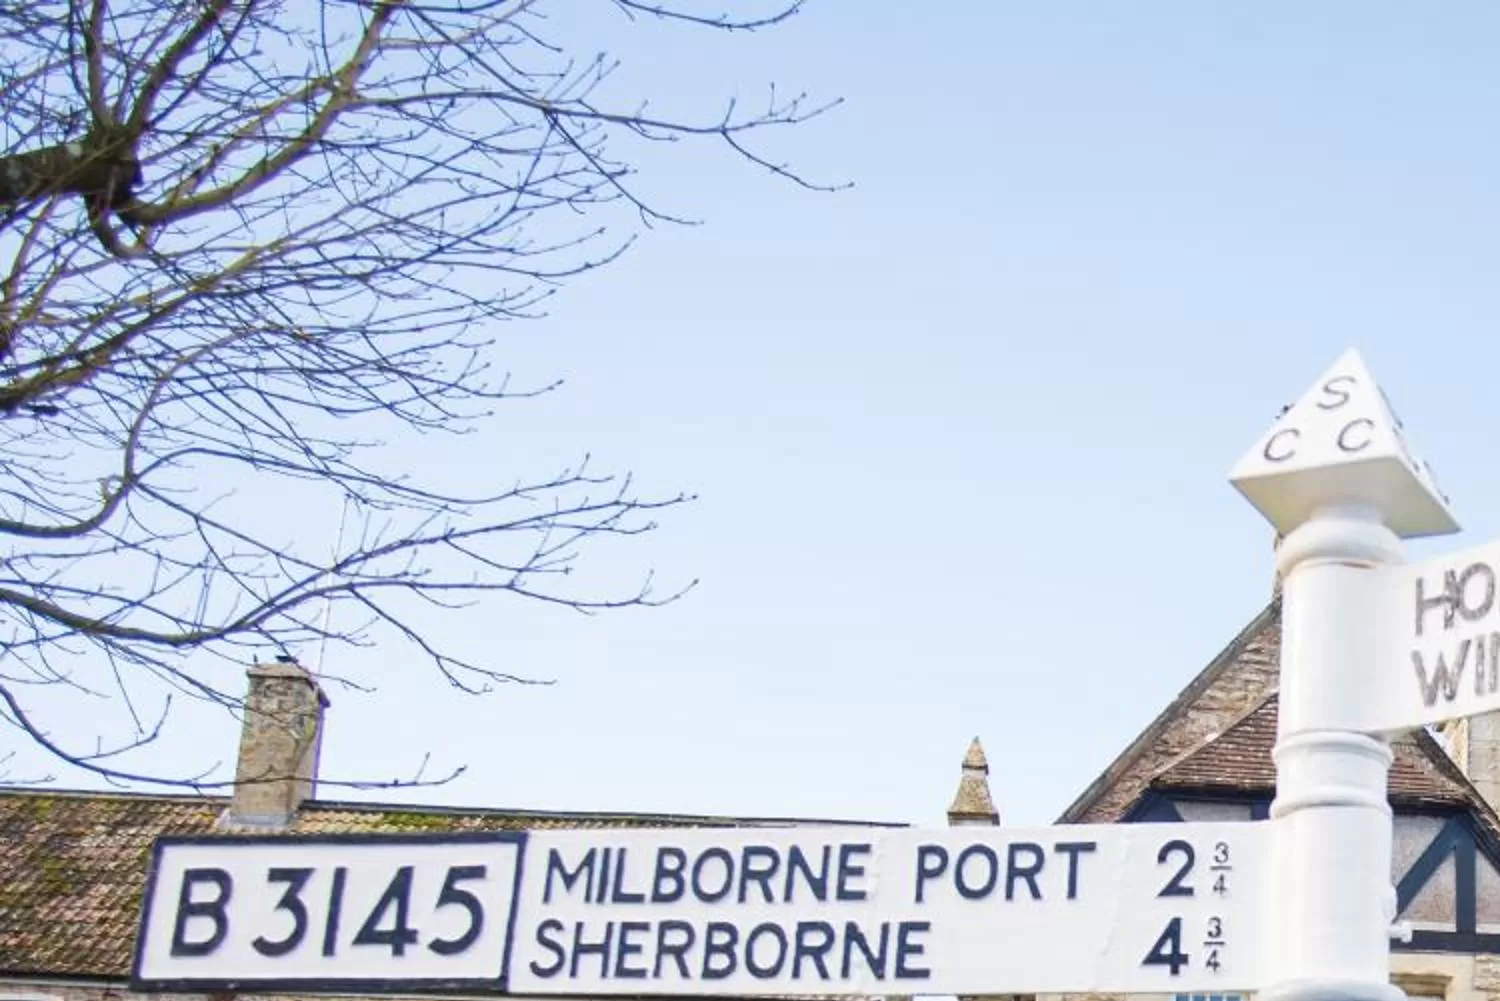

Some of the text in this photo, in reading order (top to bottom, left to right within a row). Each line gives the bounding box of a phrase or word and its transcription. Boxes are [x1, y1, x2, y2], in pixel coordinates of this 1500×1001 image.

[541, 842, 873, 905] MILBORNE
[913, 841, 1097, 902] PORT
[169, 864, 488, 958] B 3145
[528, 920, 932, 980] SHERBORNE
